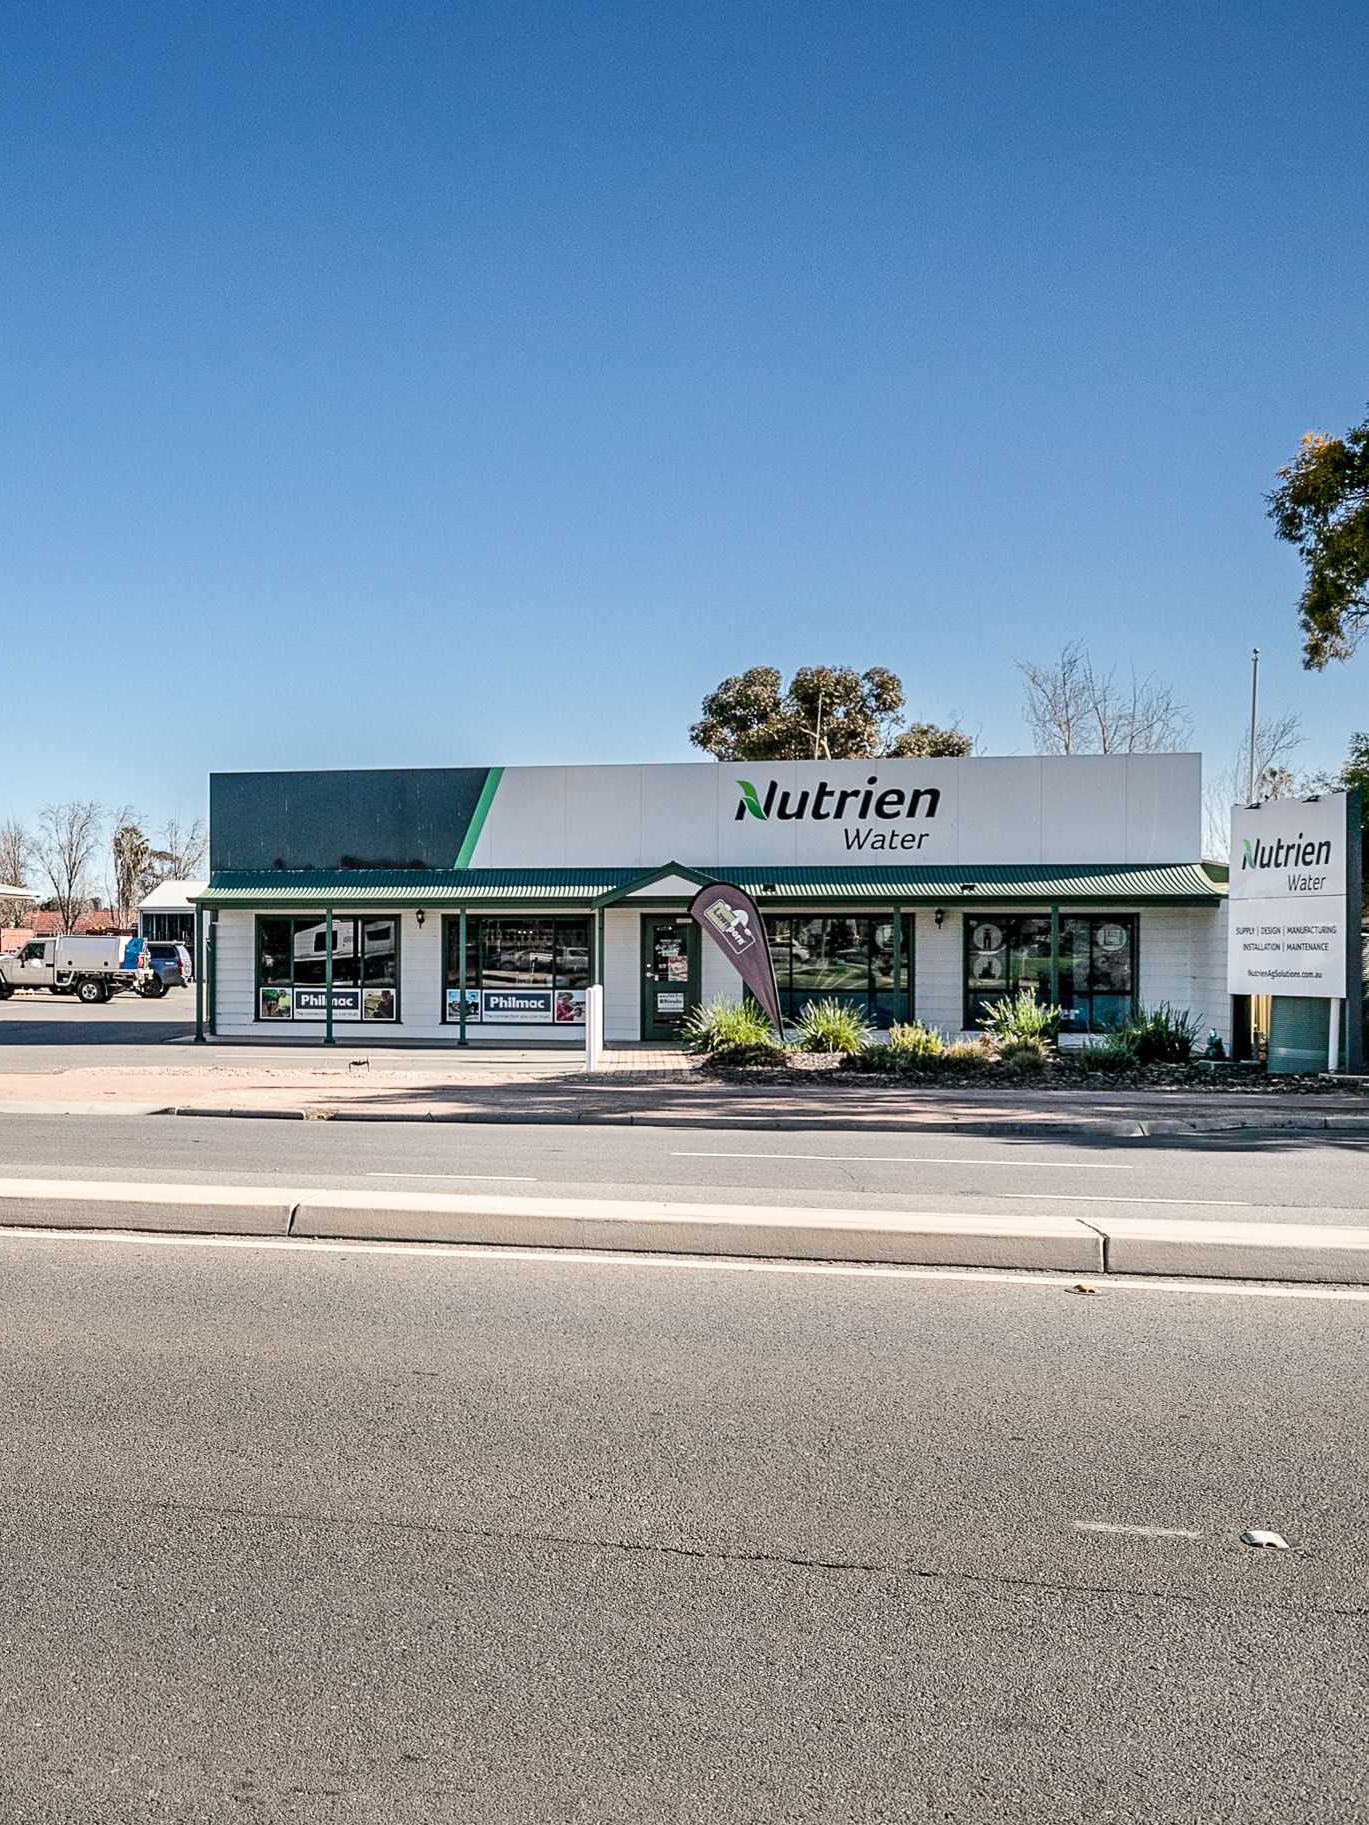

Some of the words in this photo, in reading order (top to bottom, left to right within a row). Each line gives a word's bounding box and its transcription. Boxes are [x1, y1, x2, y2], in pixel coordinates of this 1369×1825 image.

[734, 775, 941, 821] Nutrien
[844, 827, 930, 850] Water
[1241, 832, 1332, 870] Nutrien
[1287, 873, 1327, 891] Water
[713, 907, 731, 928] Lawn
[726, 925, 745, 946] porn
[1235, 926, 1255, 935] SUPPLY
[1260, 926, 1281, 935] DESIGN
[1286, 925, 1337, 934] MANUFACTURING
[1243, 942, 1281, 951] INSTALLATION
[1286, 942, 1329, 951] MAINTENANCE
[1247, 969, 1323, 980] NutrienAgSolutions.com.au
[490, 996, 545, 1009] Philmac
